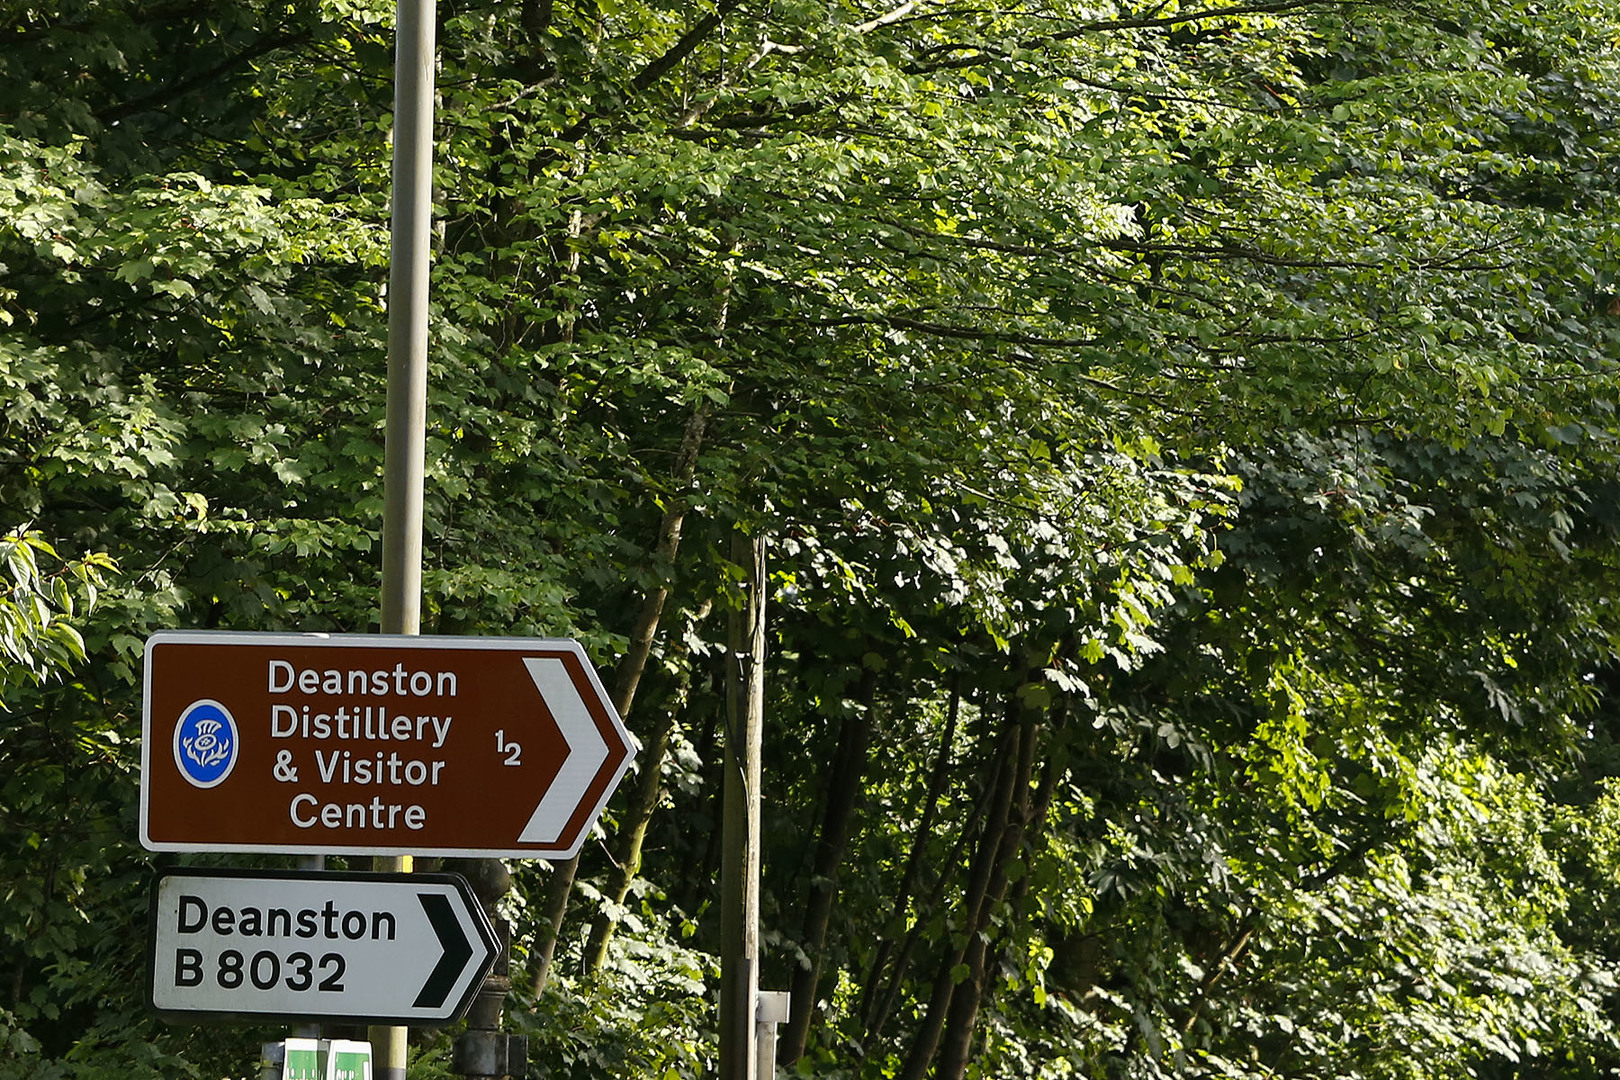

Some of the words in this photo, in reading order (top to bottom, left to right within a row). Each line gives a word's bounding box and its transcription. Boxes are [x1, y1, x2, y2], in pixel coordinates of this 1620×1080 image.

[268, 659, 458, 697] Deanston
[271, 704, 452, 747] Distillery
[273, 749, 299, 783] &
[316, 749, 446, 786] Visitor
[289, 794, 426, 831] Centre
[176, 895, 397, 941] Deanston
